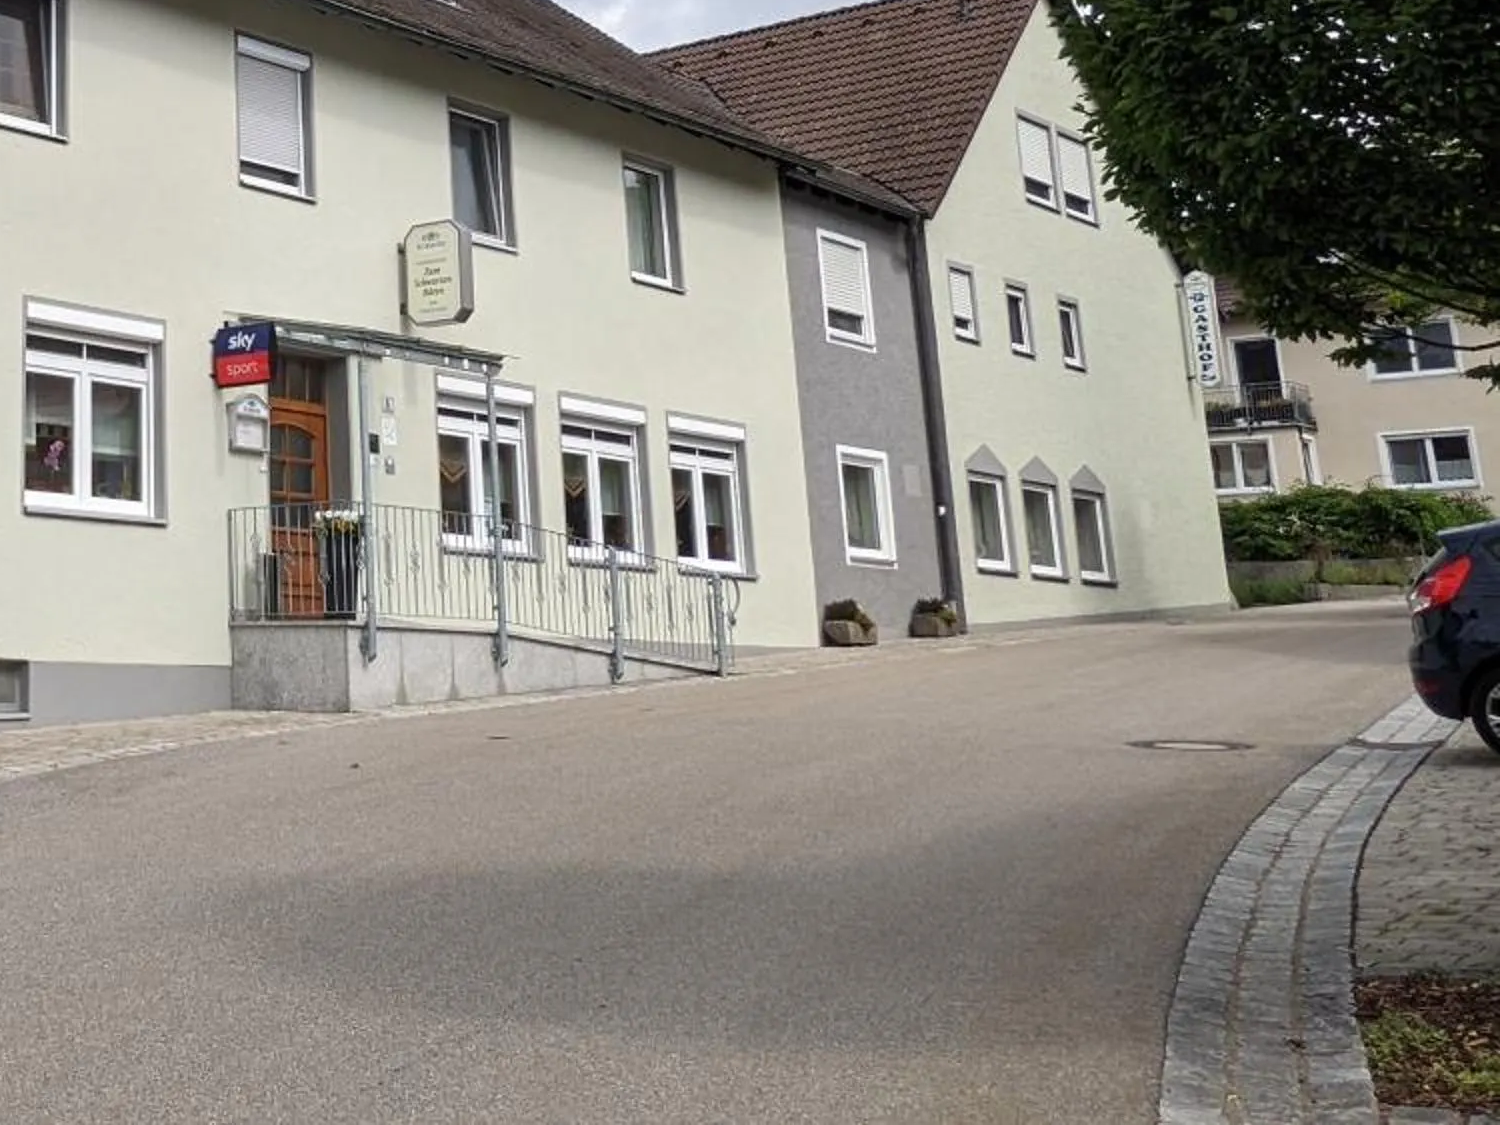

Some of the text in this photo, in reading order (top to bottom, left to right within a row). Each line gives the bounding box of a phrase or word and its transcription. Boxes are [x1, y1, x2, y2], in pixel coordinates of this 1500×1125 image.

[227, 330, 256, 351] sky
[1192, 304, 1214, 371] GASTHOF
[226, 360, 260, 378] sport
